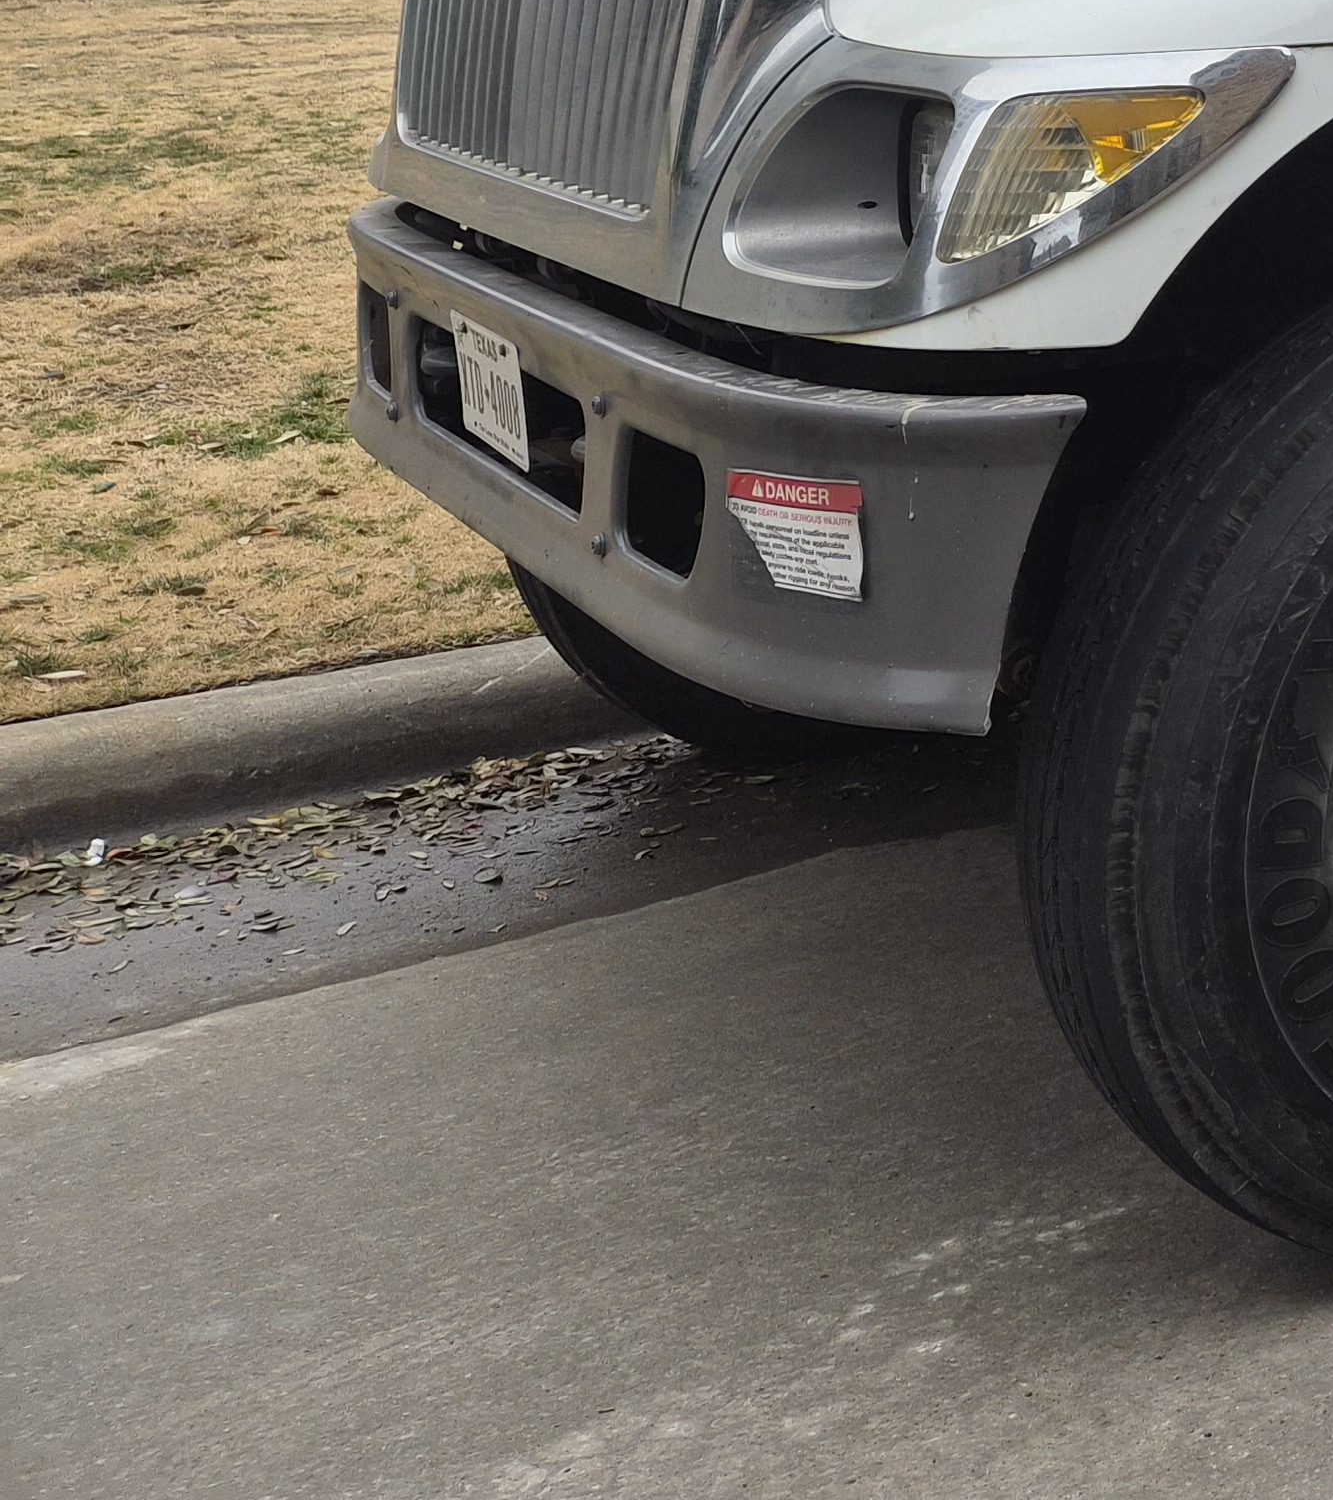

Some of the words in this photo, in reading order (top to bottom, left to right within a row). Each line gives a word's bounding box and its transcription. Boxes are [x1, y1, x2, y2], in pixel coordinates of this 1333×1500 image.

[470, 329, 498, 363] TEXAS
[766, 481, 830, 506] DANGER
[758, 507, 778, 518] DEATH
[779, 510, 789, 520] OR
[791, 511, 822, 524] SERIOUS
